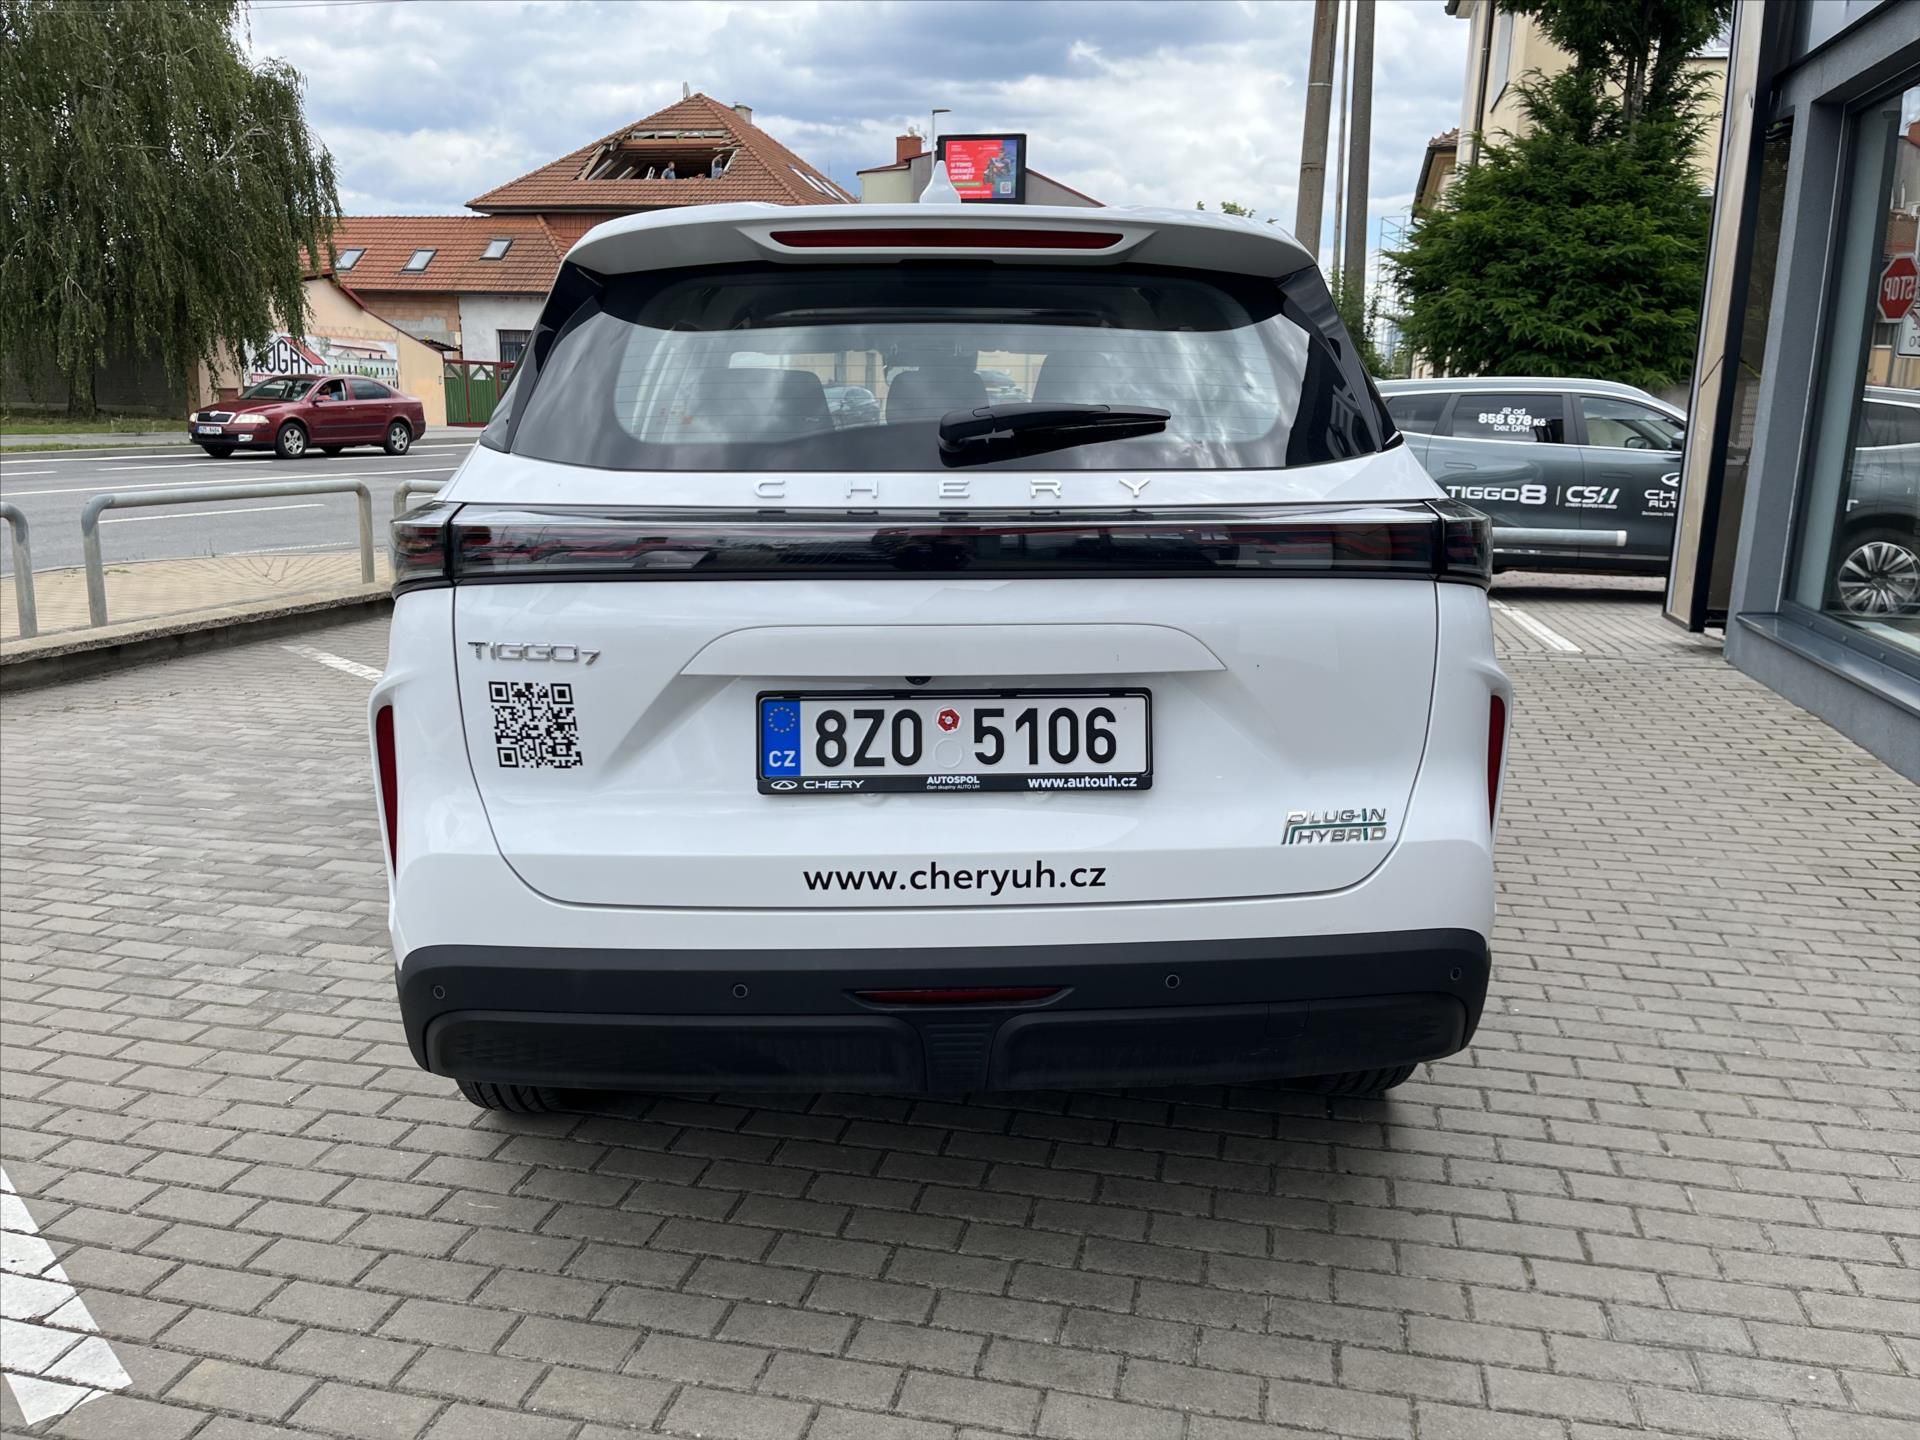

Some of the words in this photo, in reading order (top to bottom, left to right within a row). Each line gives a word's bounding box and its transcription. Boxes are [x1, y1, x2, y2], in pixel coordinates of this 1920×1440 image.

[1478, 413, 1505, 424] 858
[1507, 414, 1532, 426] 678
[1533, 418, 1546, 426] Kč
[753, 479, 1151, 498] CHERY
[768, 750, 796, 768] CZ
[815, 709, 923, 768] 8Z0
[973, 707, 1117, 766] 5106
[803, 779, 865, 790] CHERY
[926, 776, 980, 784] AUTOSPOL
[1028, 775, 1138, 788] www.autouh.cz
[1281, 807, 1386, 844] PLUG-IN
[1296, 827, 1387, 844] HYBRID
[803, 860, 1106, 895] www.cheryuh.cz
